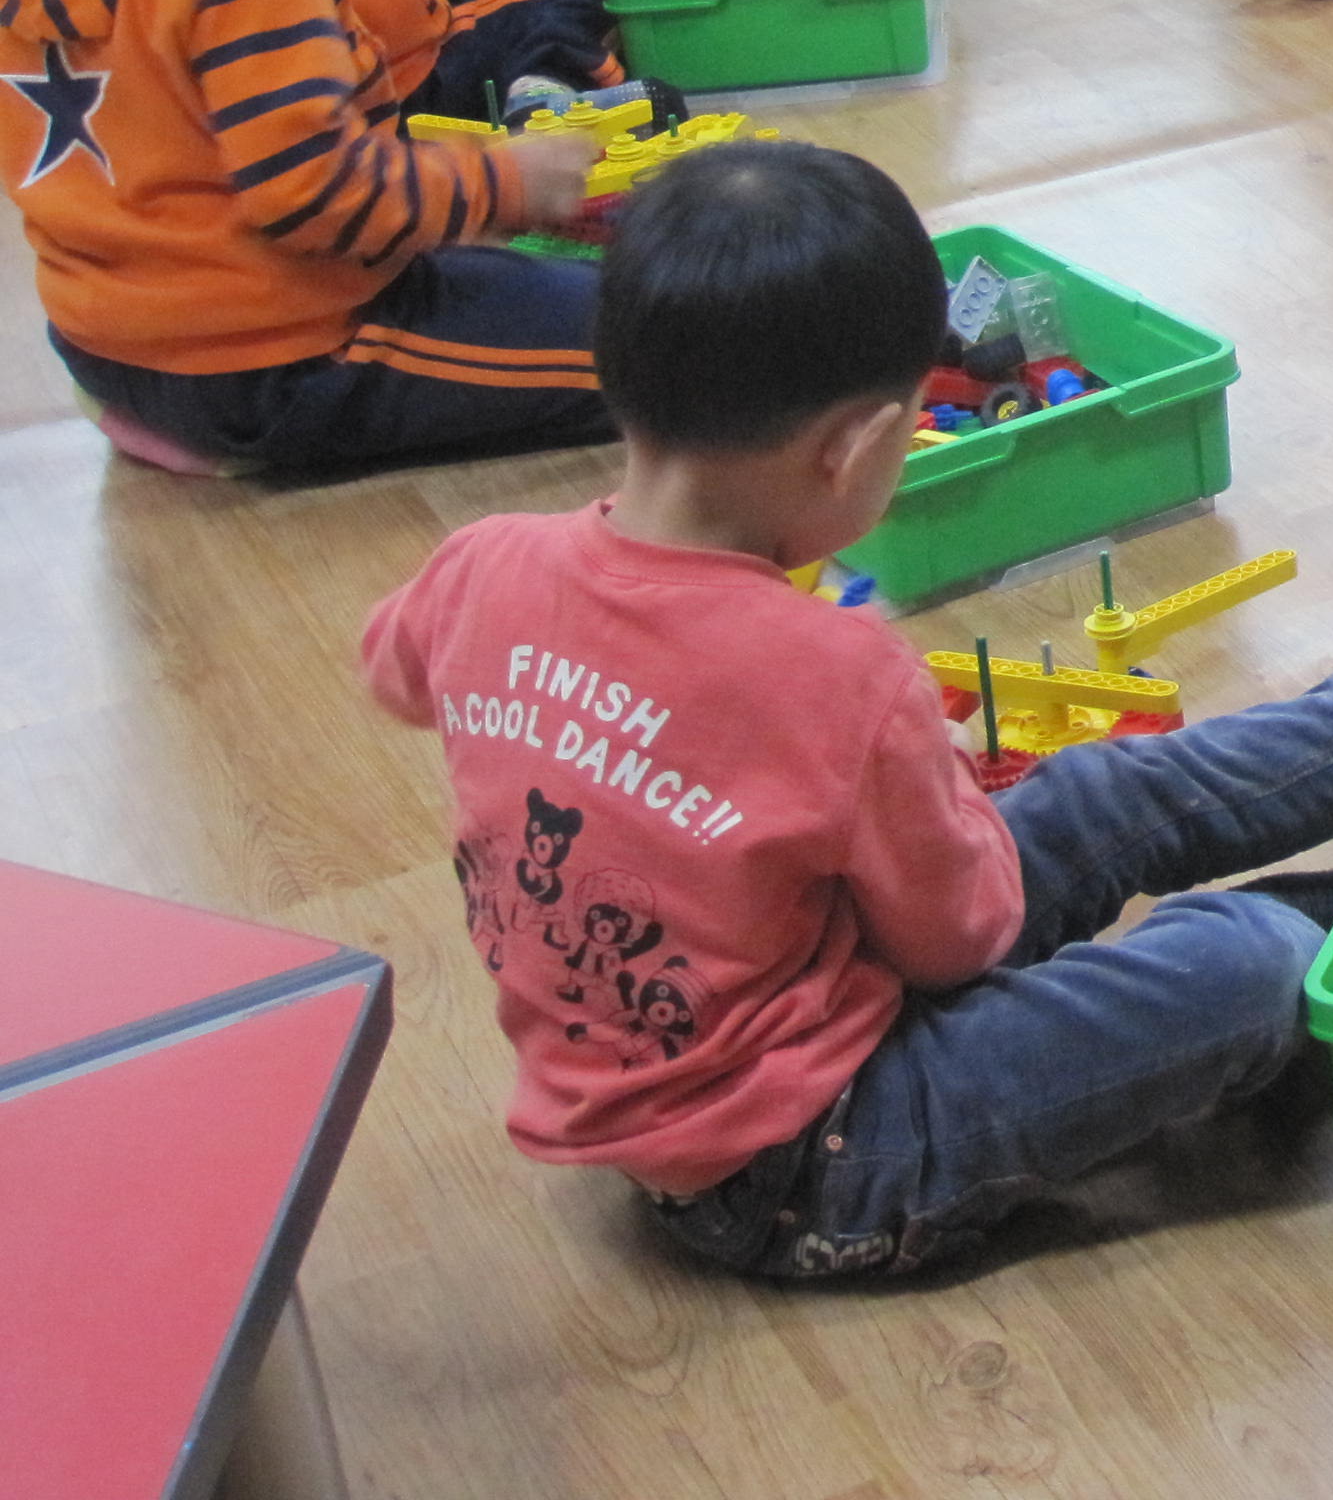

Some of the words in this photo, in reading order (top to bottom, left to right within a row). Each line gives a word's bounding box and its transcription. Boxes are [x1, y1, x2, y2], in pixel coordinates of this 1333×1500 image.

[510, 644, 670, 748] FINISH
[444, 693, 462, 736] A
[466, 693, 544, 749] COOL
[556, 718, 744, 847] DANCE!!
